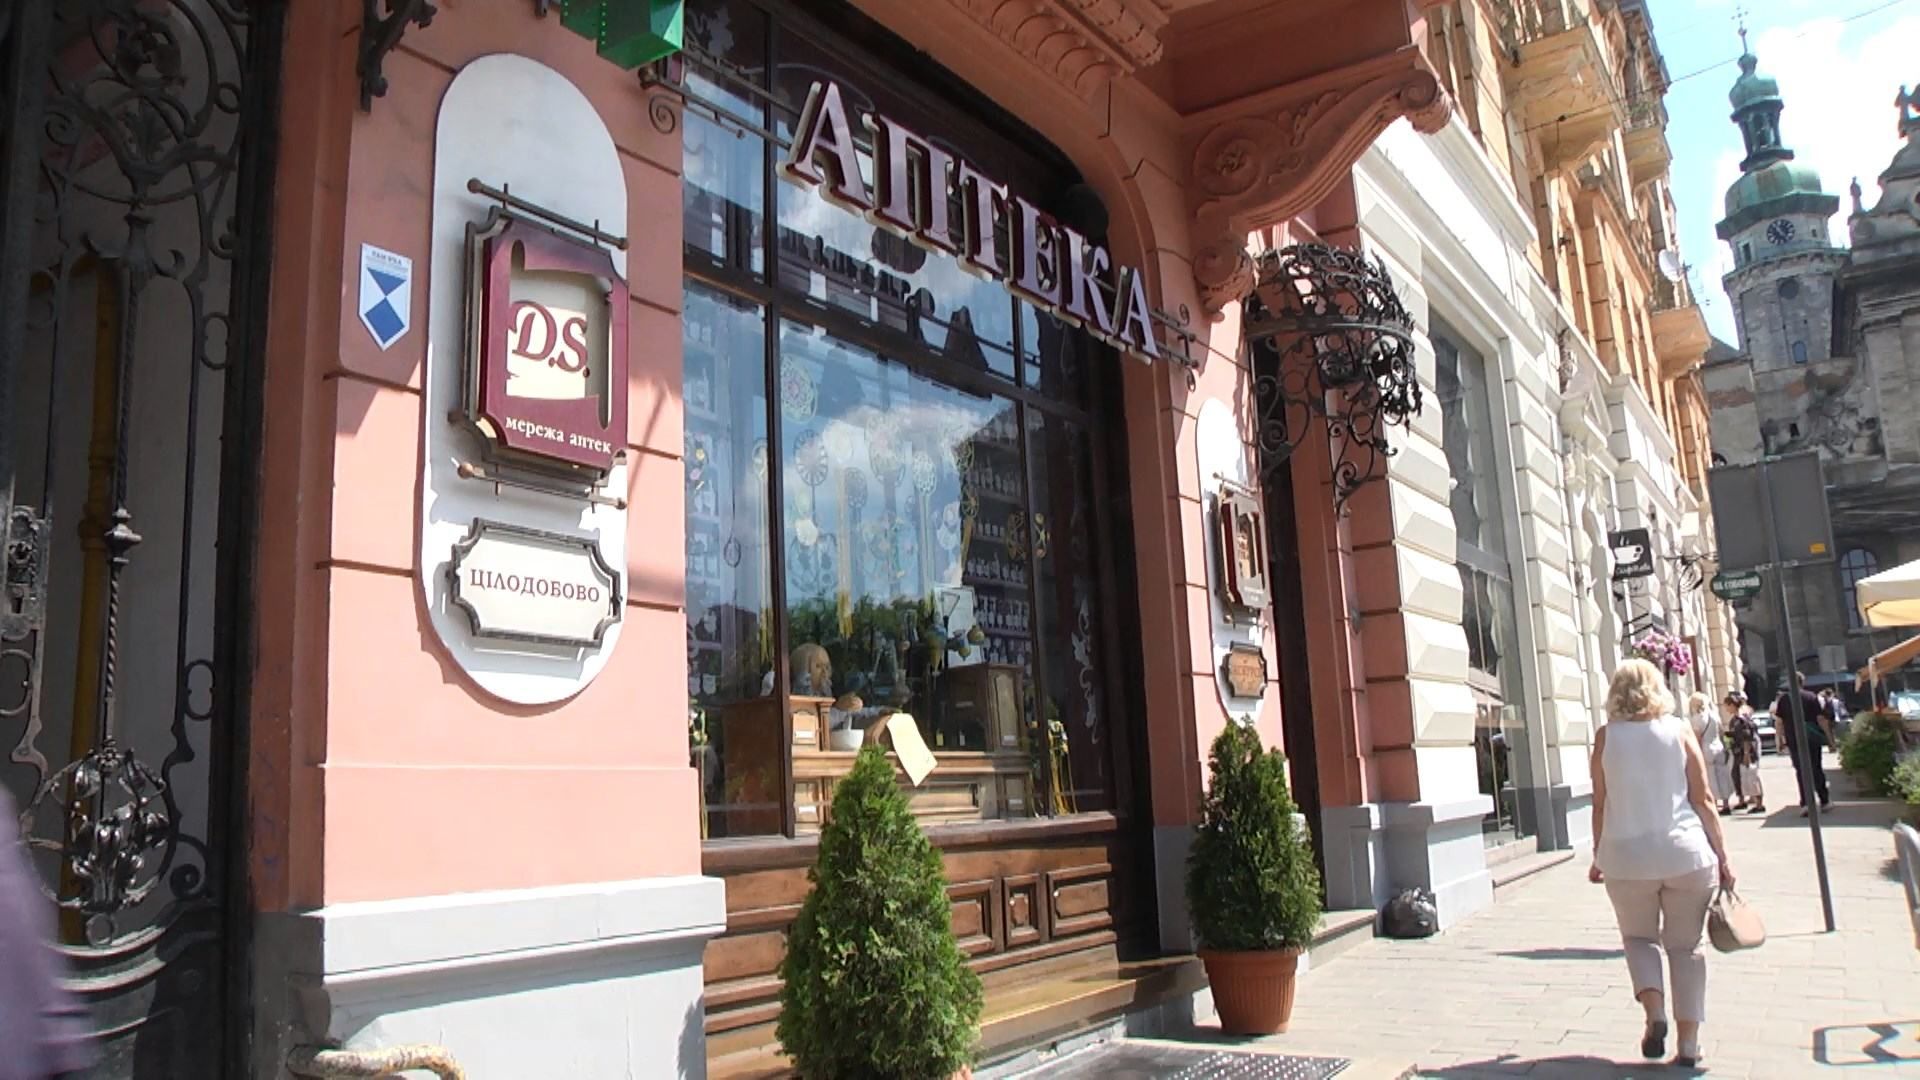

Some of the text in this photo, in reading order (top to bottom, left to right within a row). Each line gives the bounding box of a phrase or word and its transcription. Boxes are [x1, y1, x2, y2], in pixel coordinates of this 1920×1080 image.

[776, 80, 1160, 364] АПТЕКА
[505, 416, 612, 454] мережа аптек
[470, 569, 600, 602] ЦІЛОДОБОВО
